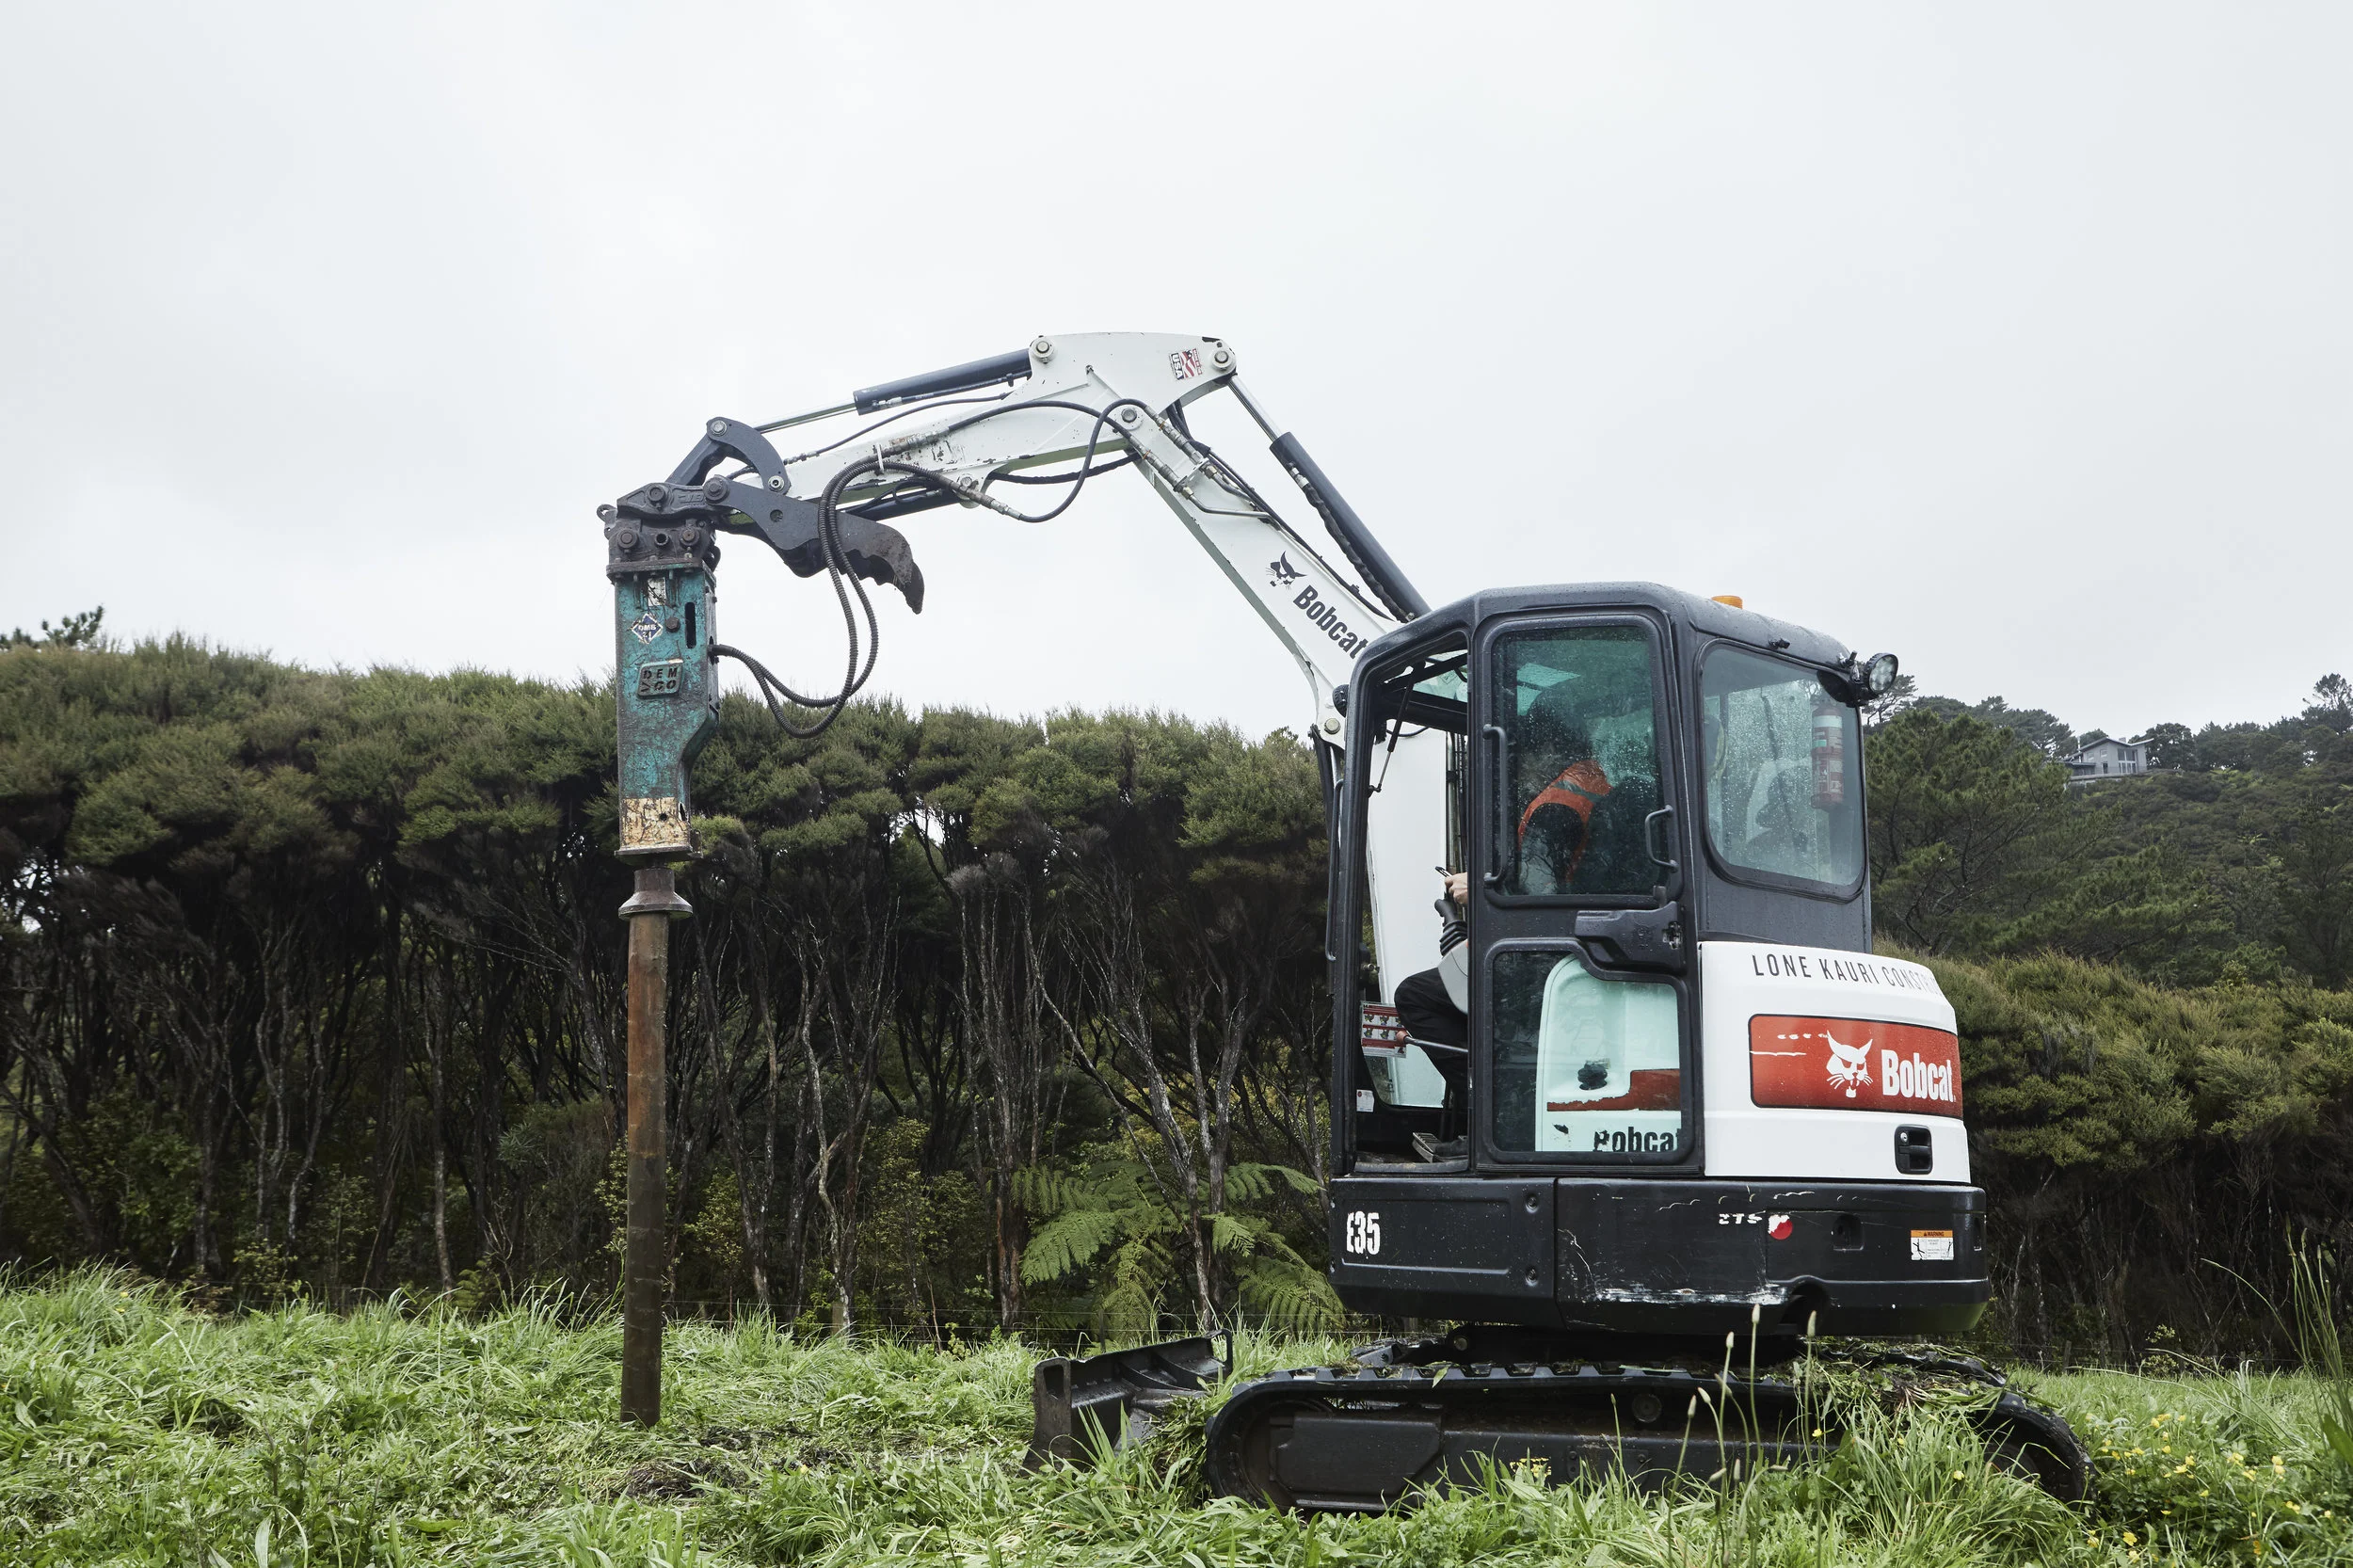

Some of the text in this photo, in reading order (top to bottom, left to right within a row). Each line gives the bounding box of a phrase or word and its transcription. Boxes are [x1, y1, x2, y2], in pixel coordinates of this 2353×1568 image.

[1172, 353, 1184, 378] USA
[1293, 584, 1369, 660] Bobcat
[643, 667, 678, 679] DEM
[1752, 953, 1811, 978] LONE
[1818, 958, 1880, 984] KAURI
[1881, 1049, 1953, 1102] Bobcat
[1347, 1210, 1381, 1256] E35
